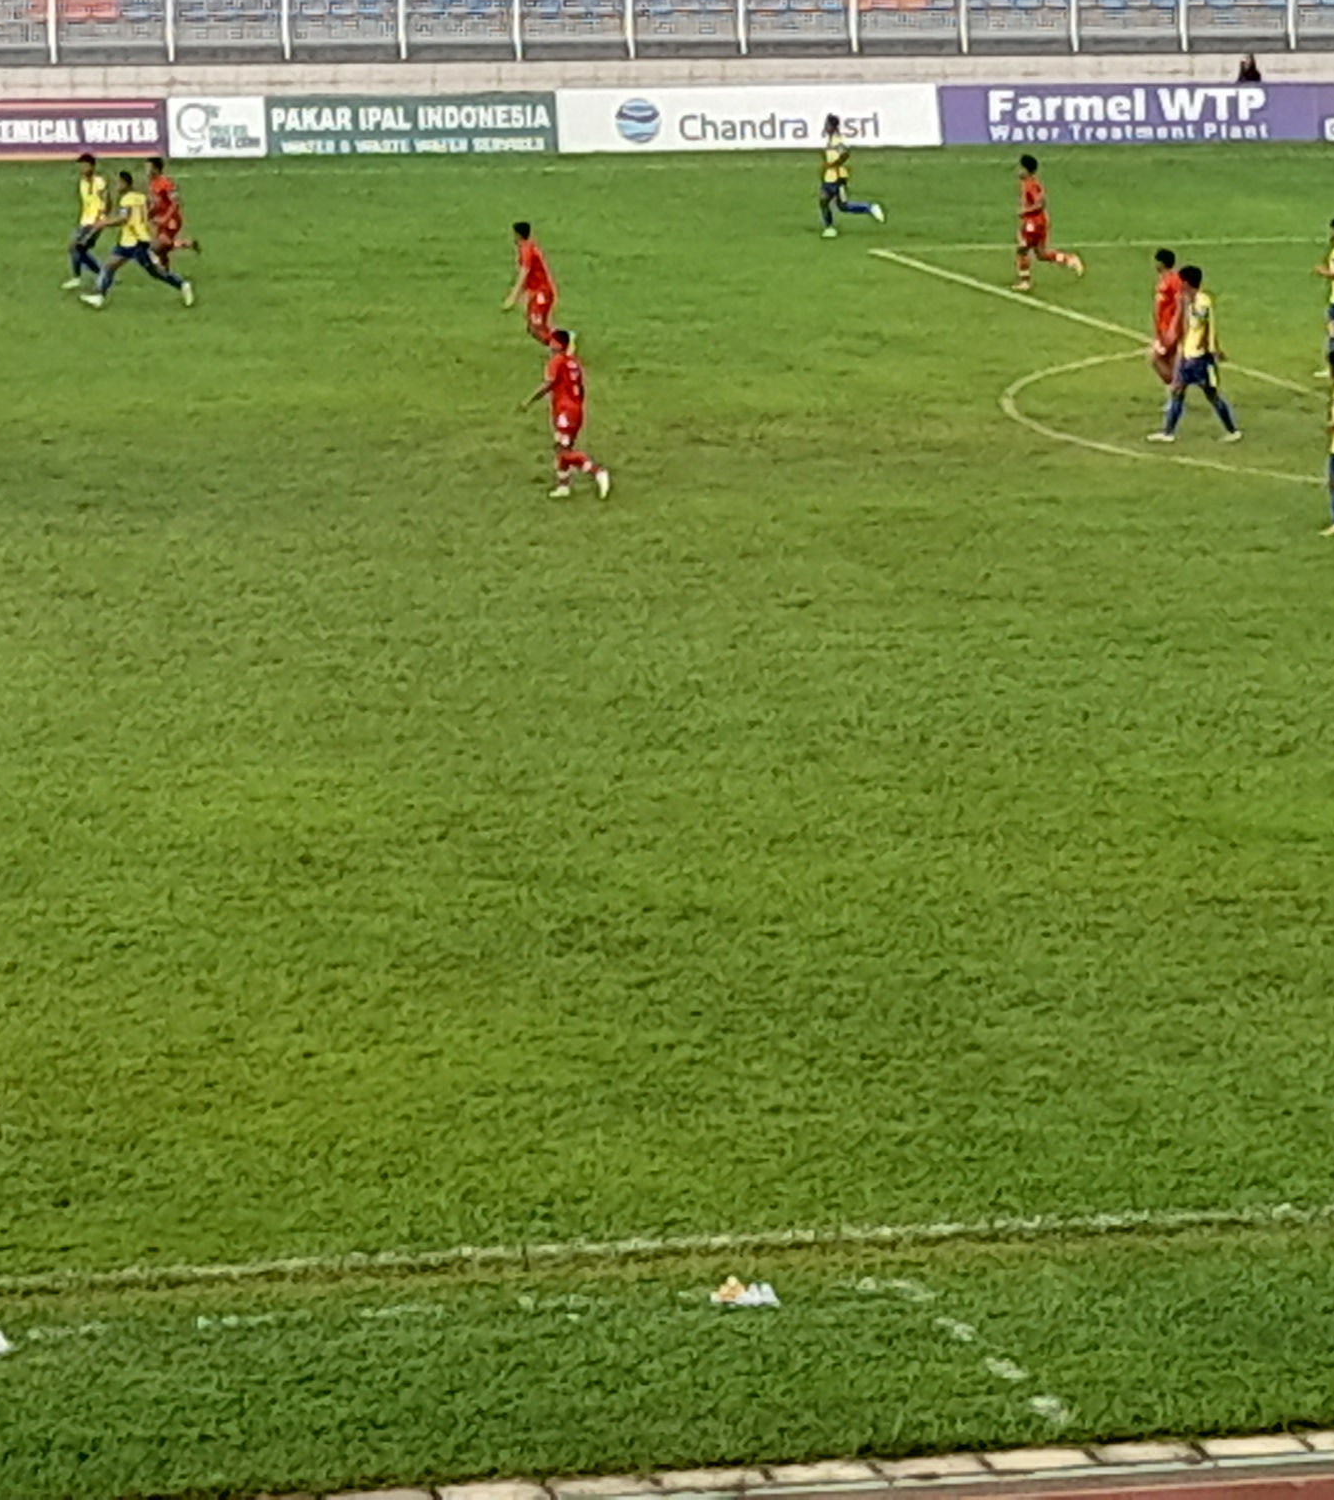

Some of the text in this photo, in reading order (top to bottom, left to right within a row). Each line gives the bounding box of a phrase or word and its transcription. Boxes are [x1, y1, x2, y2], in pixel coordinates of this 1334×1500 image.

[271, 103, 551, 132] PAKAR IPAL INDONESIA
[988, 87, 1266, 122] Farmel WTP
[82, 118, 159, 143] WATER
[679, 112, 809, 140] Chandra
[989, 122, 1269, 141] Water Treatment Plant
